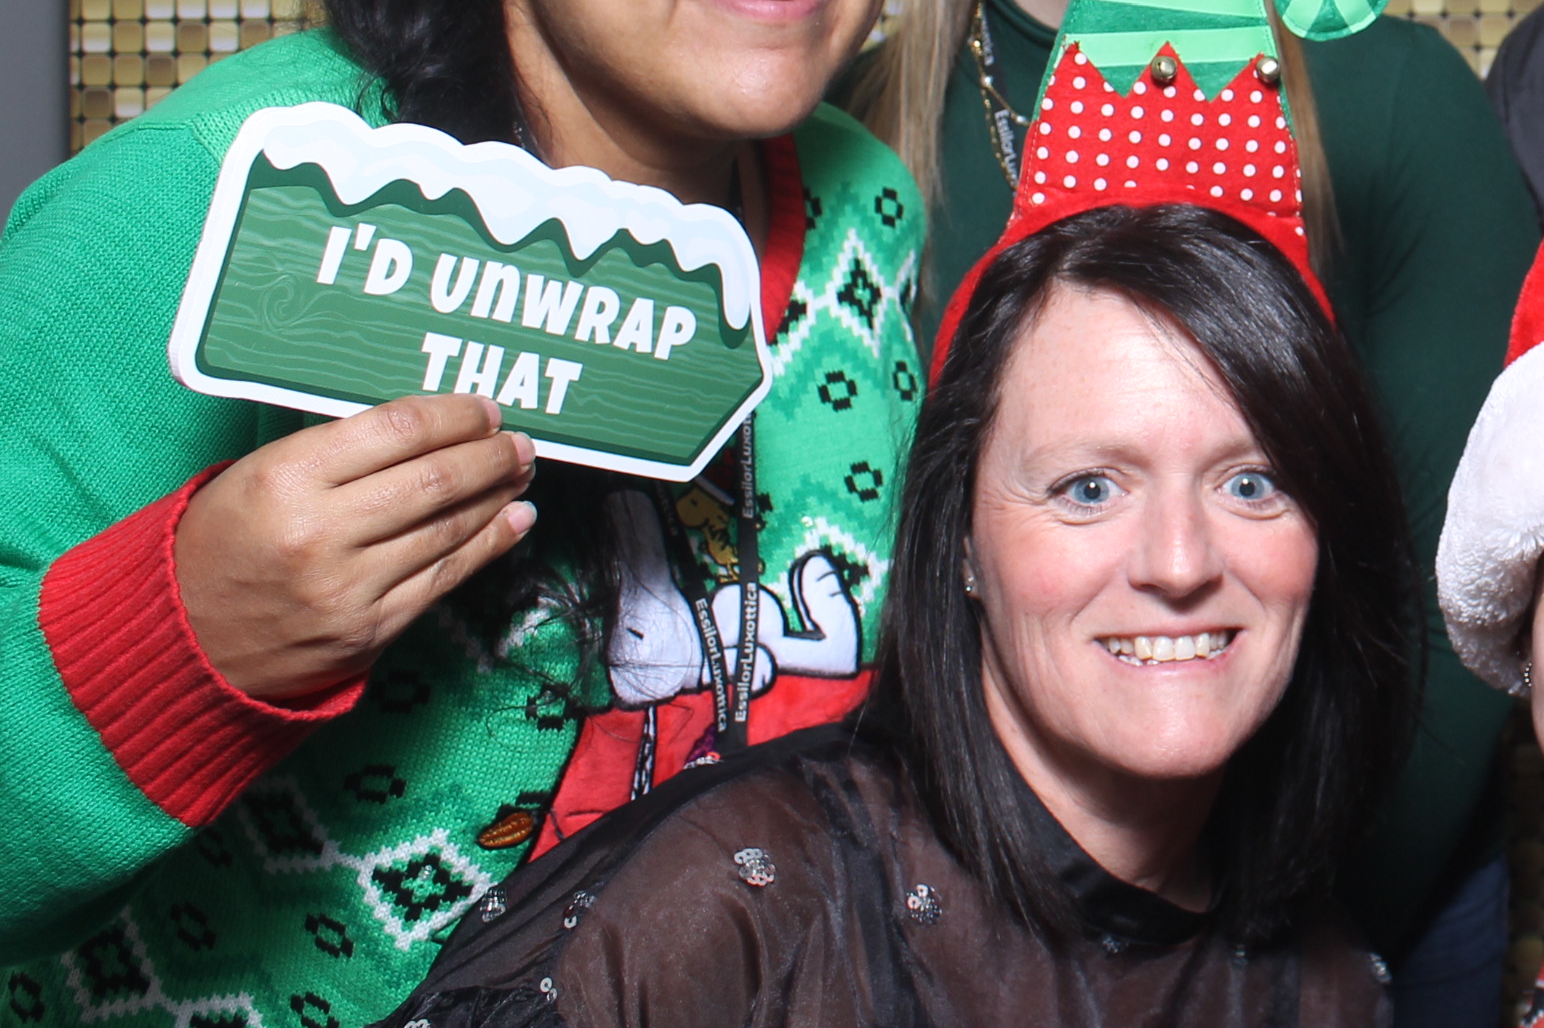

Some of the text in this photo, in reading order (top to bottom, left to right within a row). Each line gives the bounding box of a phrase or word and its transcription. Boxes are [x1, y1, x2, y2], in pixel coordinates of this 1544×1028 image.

[316, 222, 413, 296] I'D
[420, 332, 583, 415] THAT
[695, 597, 728, 733] EssilorLuxottica
[734, 582, 757, 723] EssilorLuxottica
